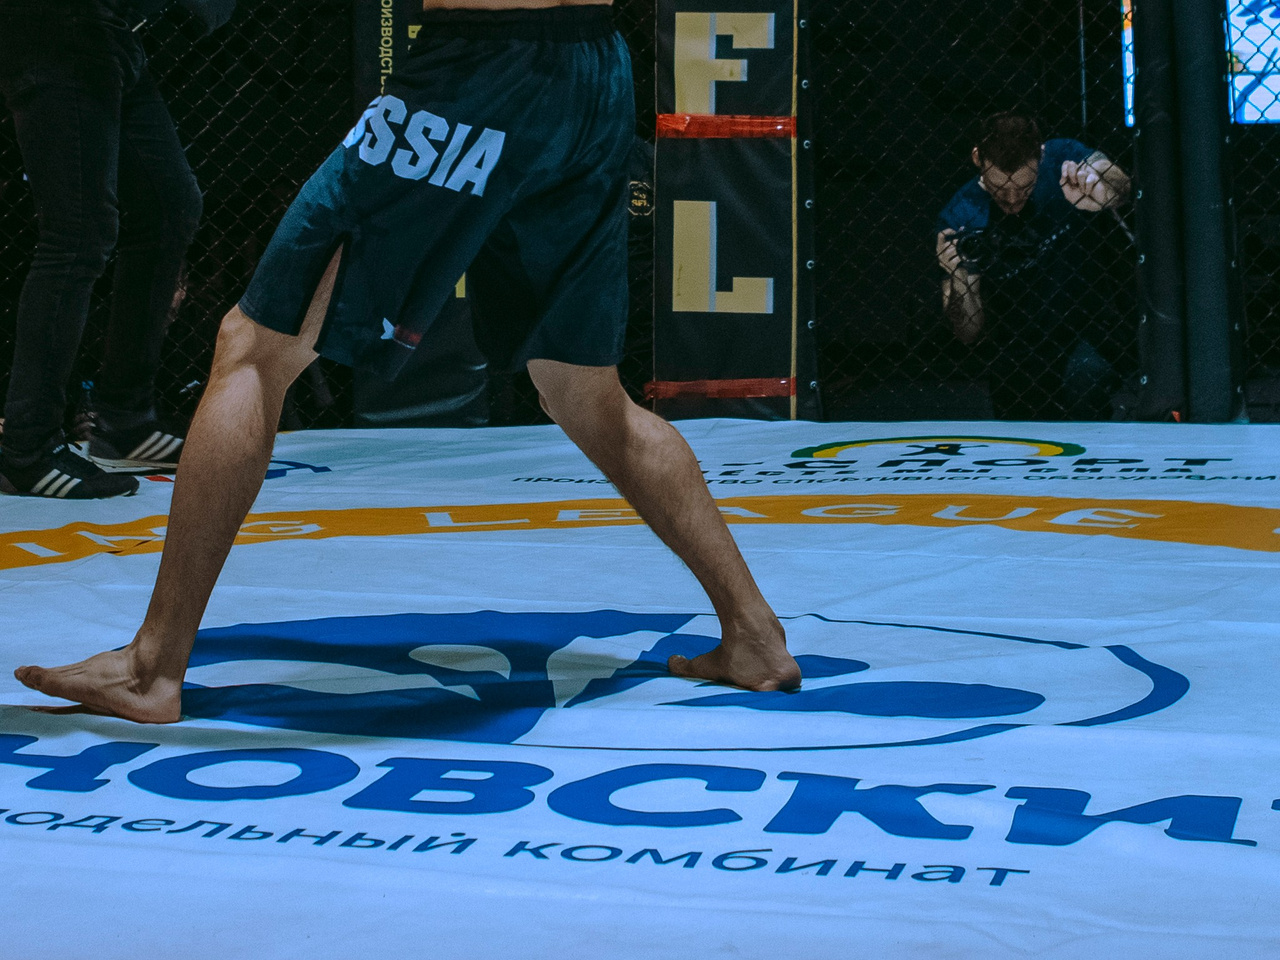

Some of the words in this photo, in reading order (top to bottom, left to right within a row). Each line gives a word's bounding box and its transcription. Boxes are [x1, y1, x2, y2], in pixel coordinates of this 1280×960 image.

[342, 94, 506, 198] SSIA
[1023, 473, 1280, 481] ОБОРУДОВАНИ
[503, 841, 1032, 887] комбинат
